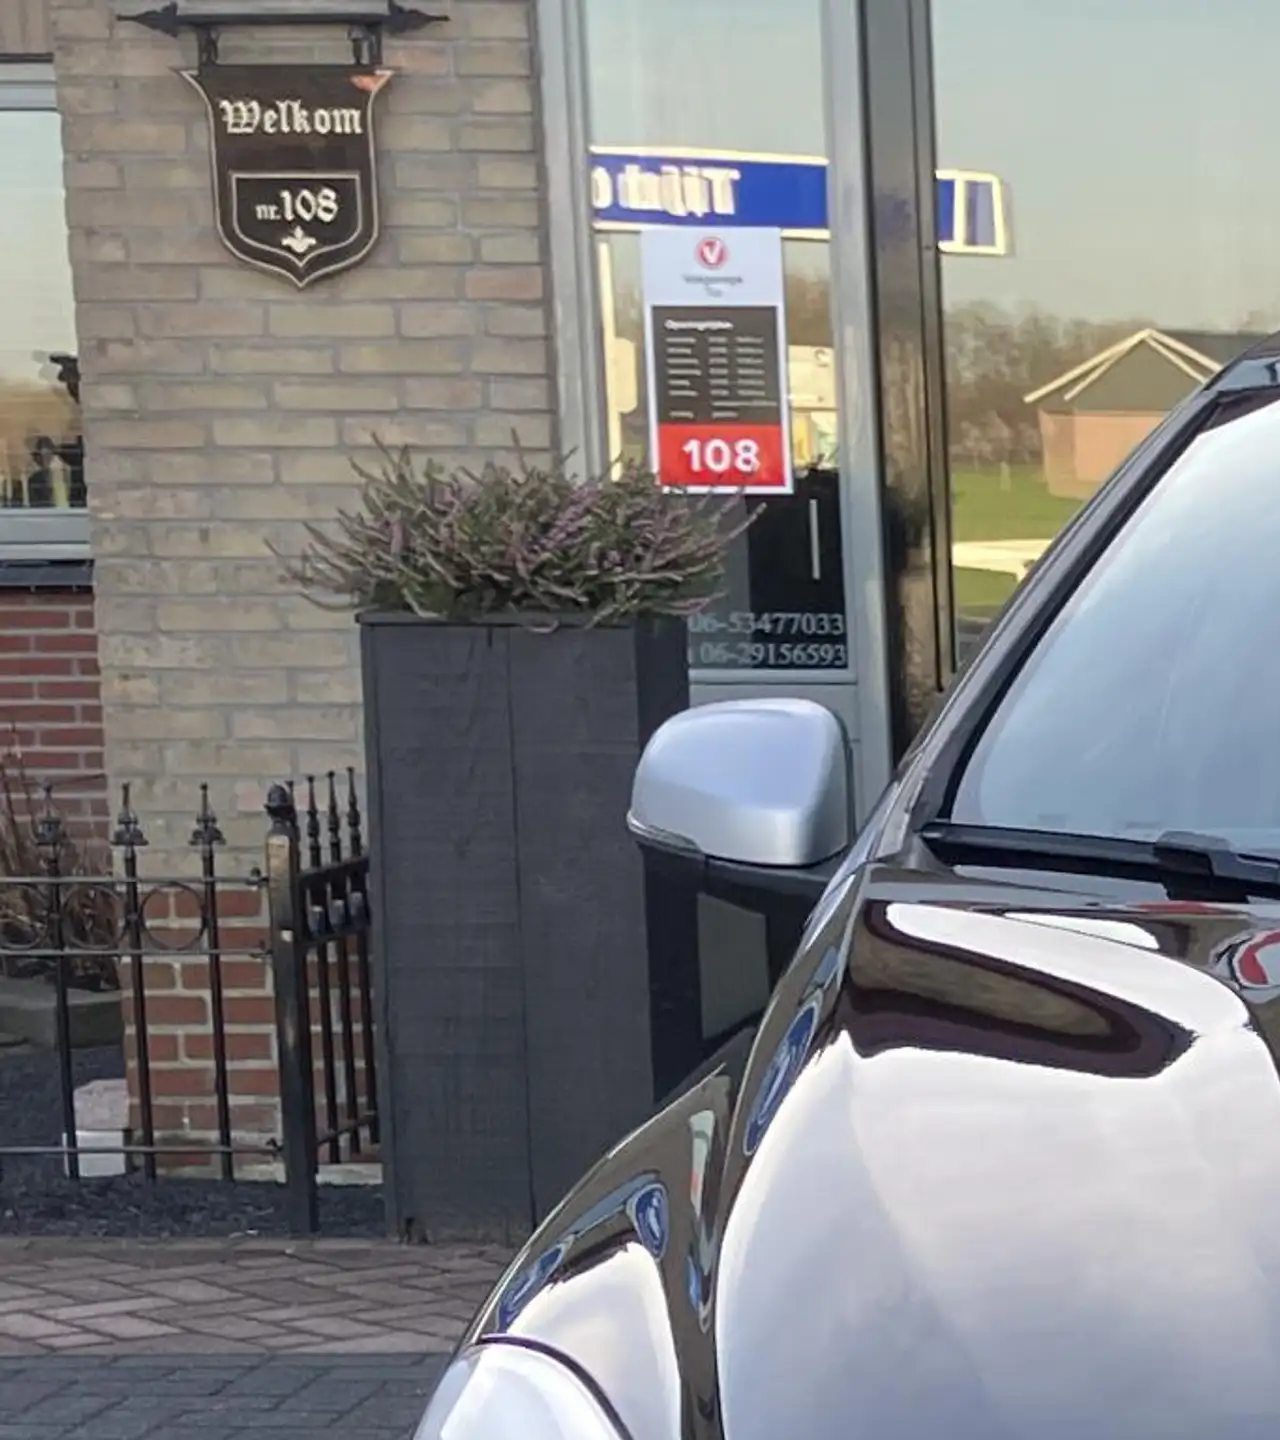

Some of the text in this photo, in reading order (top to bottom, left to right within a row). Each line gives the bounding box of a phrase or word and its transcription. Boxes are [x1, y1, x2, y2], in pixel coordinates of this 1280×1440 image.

[218, 99, 364, 135] Welkom
[682, 438, 762, 472] 108
[690, 611, 845, 635] 06-53477033
